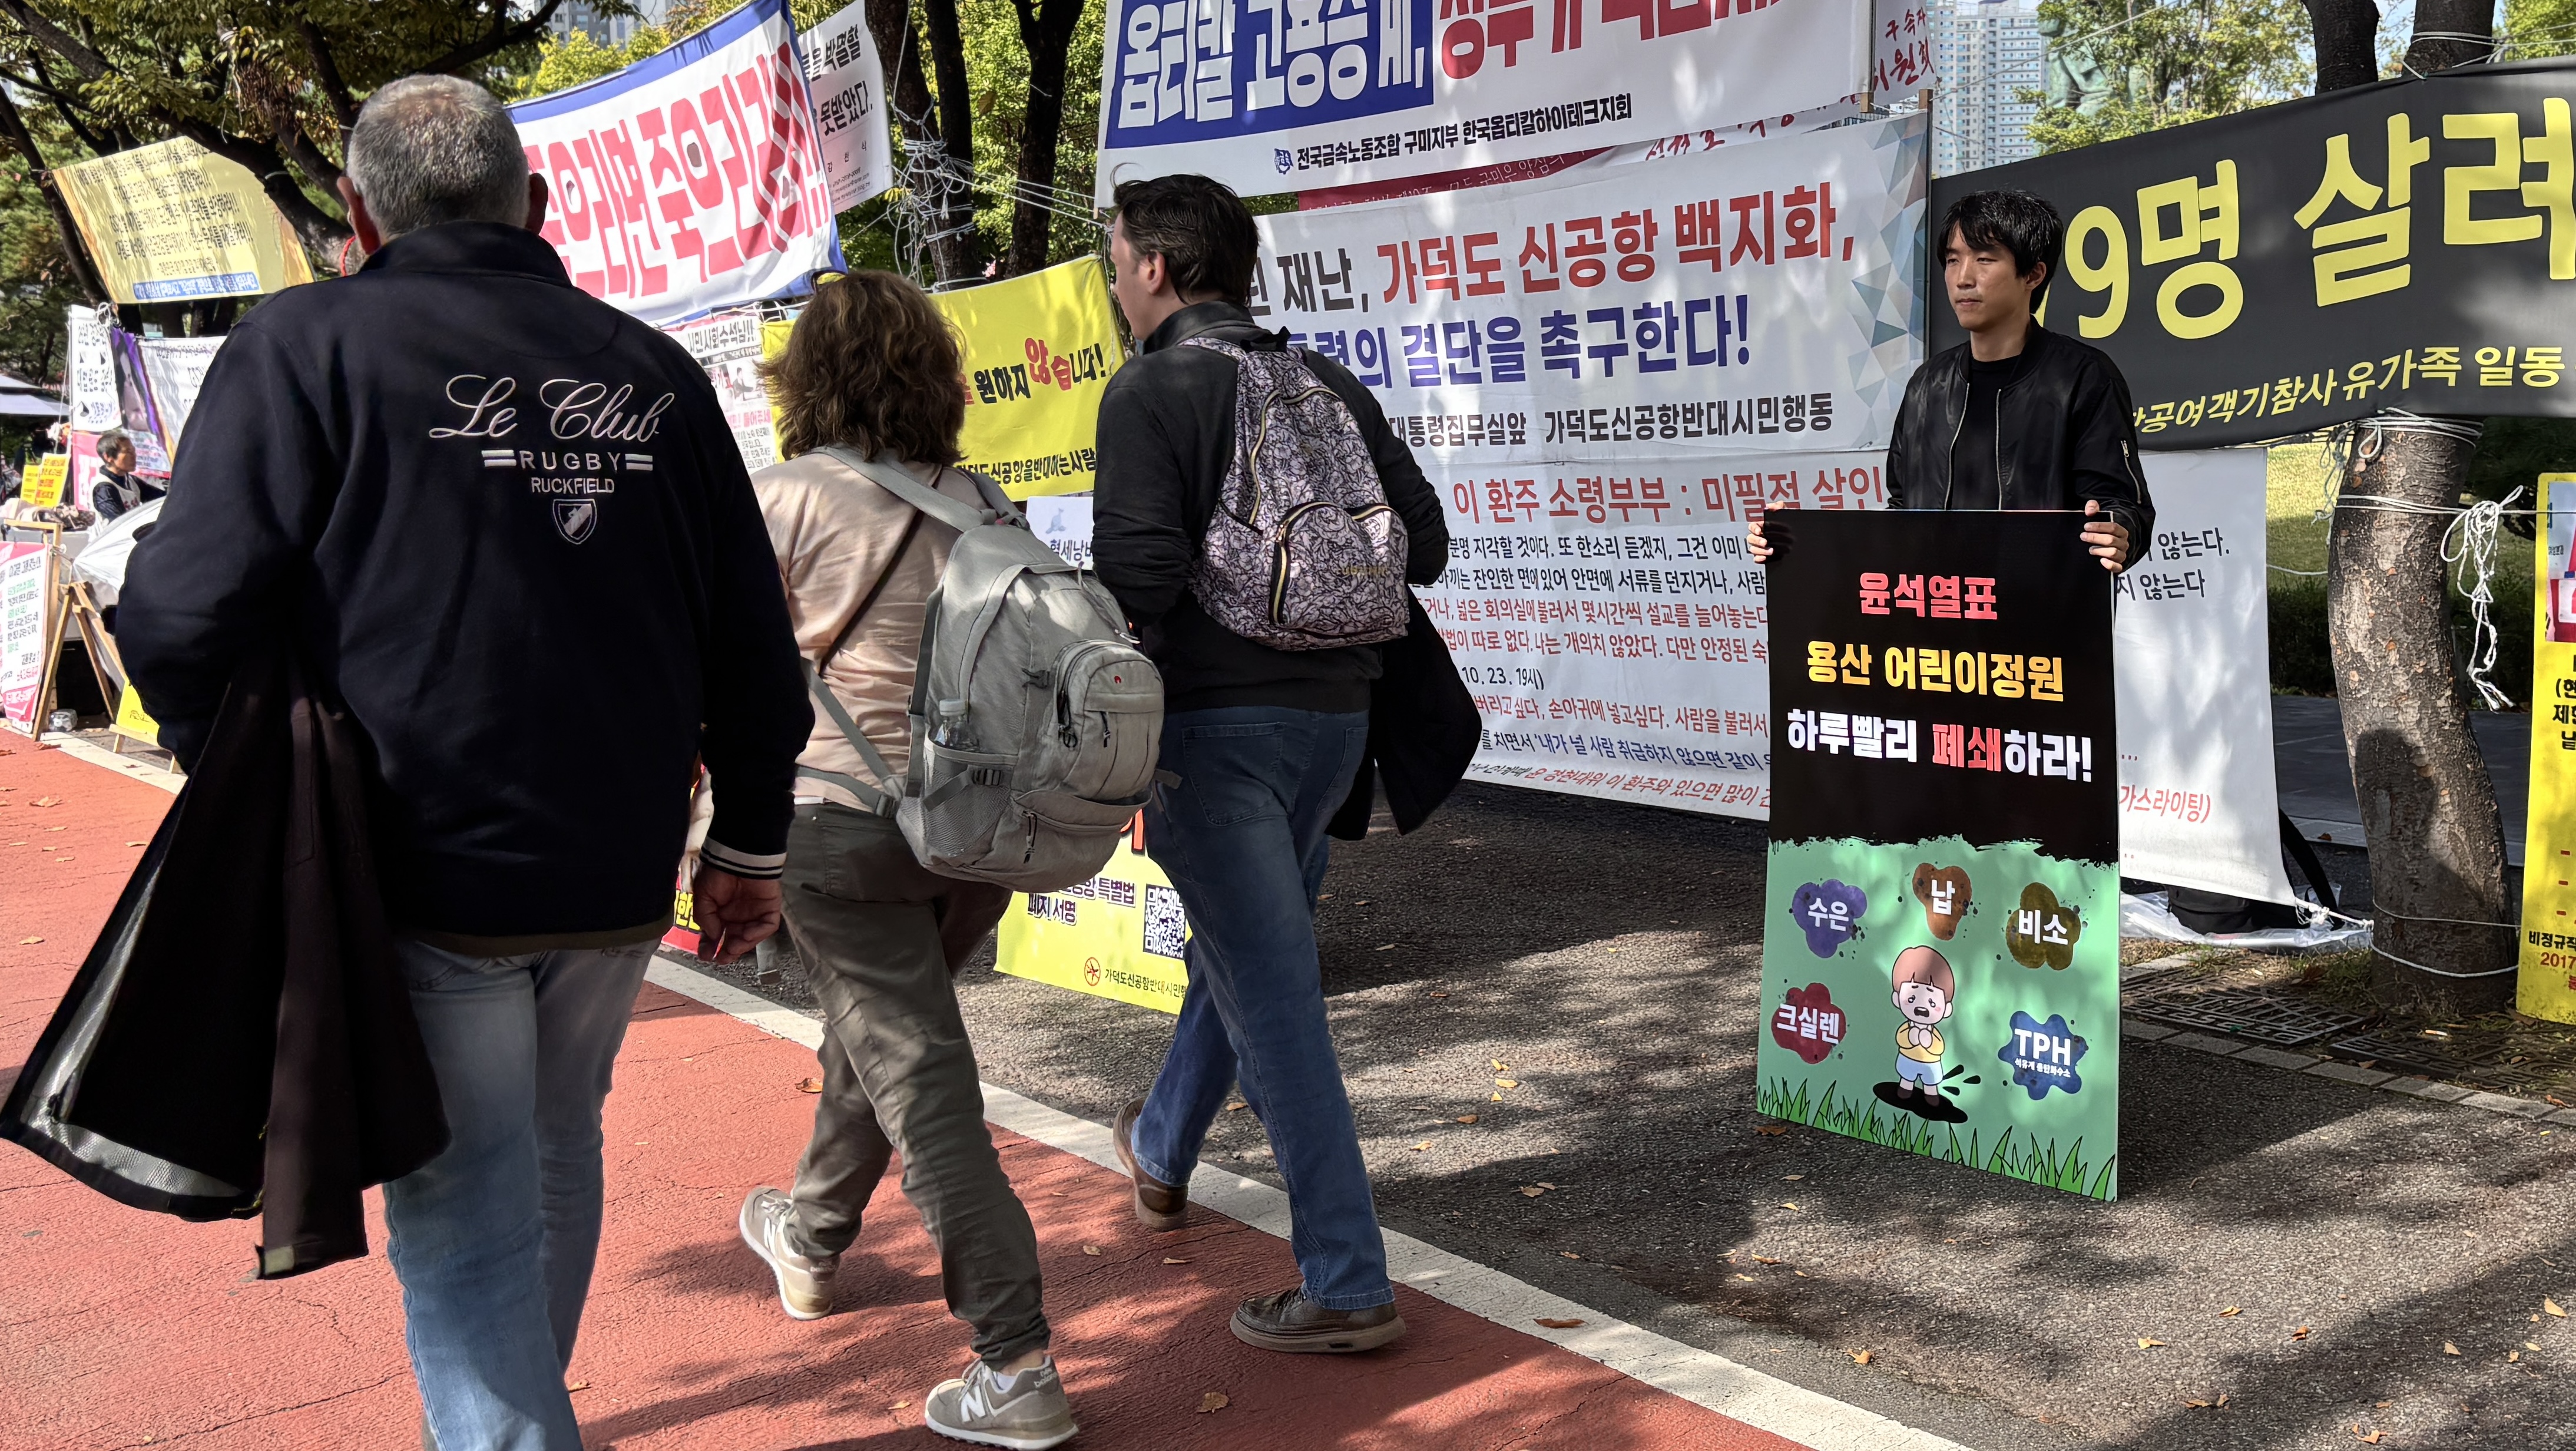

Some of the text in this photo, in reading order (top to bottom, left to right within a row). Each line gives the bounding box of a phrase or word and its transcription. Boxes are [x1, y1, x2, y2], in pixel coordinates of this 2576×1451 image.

[1118, 0, 1234, 129] 옵티칼
[1297, 133, 1401, 171] 전국금속노동조합
[1404, 123, 1459, 155] 구미지부
[1462, 92, 1632, 146] 한국옵티칼하이테크지회
[2033, 97, 2576, 340] 9명 살려
[1276, 247, 1369, 314] 재난,
[1376, 232, 1506, 305] 가덕도
[1518, 208, 1659, 295] 신공항
[1674, 181, 1855, 273] 백지화,
[1400, 316, 1527, 388] 결단을
[1539, 294, 1750, 379] 촉구한다!
[974, 363, 1031, 404] 원하지
[1024, 337, 1107, 391] 않습니다!
[2341, 346, 2463, 400] 유가족
[2475, 346, 2565, 388] 일동
[428, 374, 676, 443] Le Club
[1388, 392, 1833, 448] 대통령집무실앞 가덕도신공항반대시민행동
[518, 451, 622, 471] RUGBY
[531, 477, 615, 494] RUCKFIELD
[1453, 479, 1481, 524] 이
[1485, 478, 1541, 524] 환주
[1548, 475, 1671, 524] 소령부부
[1701, 470, 1802, 523] 미필적
[1812, 465, 1883, 511] 살인
[1472, 536, 1514, 560] 지각할
[1516, 535, 1555, 559] 것이다.
[1557, 536, 1574, 557] 또
[1575, 535, 1621, 560] 한소리
[1624, 535, 1673, 561] 듣겠지,
[1677, 535, 1708, 561] 그건
[1711, 535, 1743, 561] 이미
[2157, 527, 2230, 561] 않는다.
[1472, 567, 1515, 590] 잔인한
[1570, 567, 1615, 593] 안면에
[1618, 567, 1663, 594] 서류를
[1664, 568, 1734, 596] 던지거나,
[1737, 569, 1766, 596] 사람
[1859, 571, 1998, 620] 윤석열표
[2139, 568, 2206, 601] 않는다
[1417, 596, 1455, 620] 거나,
[1456, 597, 1482, 622] 넓은
[1581, 600, 1644, 626] 몇시간씩
[1646, 601, 1691, 629] 설교를
[1471, 630, 1502, 653] 따로
[1534, 631, 1562, 656] 나는
[1563, 630, 1607, 657] 개의치
[1608, 633, 1664, 659] 않았다.
[1666, 636, 1697, 661] 다만
[1700, 636, 1749, 663] 안정된
[1806, 640, 2064, 702] 용산 어린이정원
[1548, 696, 1606, 722] 손아귀에
[1675, 706, 1720, 734] 사람을
[1723, 709, 1769, 739] 불러서
[1494, 731, 1536, 753] 치면서
[1569, 734, 1588, 756] 널
[1590, 735, 1617, 759] 사람
[1617, 739, 1678, 765] 취급하지
[1676, 747, 1728, 769] 않으면
[1724, 751, 1764, 771] 같이
[1787, 708, 2092, 783] 하루빨리 폐쇄하라!
[1621, 774, 1675, 795] 환주와
[1670, 779, 1724, 802] 있으면
[1721, 784, 1760, 806] 많이
[2119, 784, 2211, 824] 가스라이팅)
[1052, 898, 1077, 924] 서명
[1098, 877, 1135, 906] 특별법
[1931, 878, 1956, 915] 납
[1807, 897, 1849, 932] 수은
[2018, 909, 2069, 946] 비소
[1776, 1003, 1840, 1045] 크실렌
[2014, 1027, 2071, 1066] TPH
